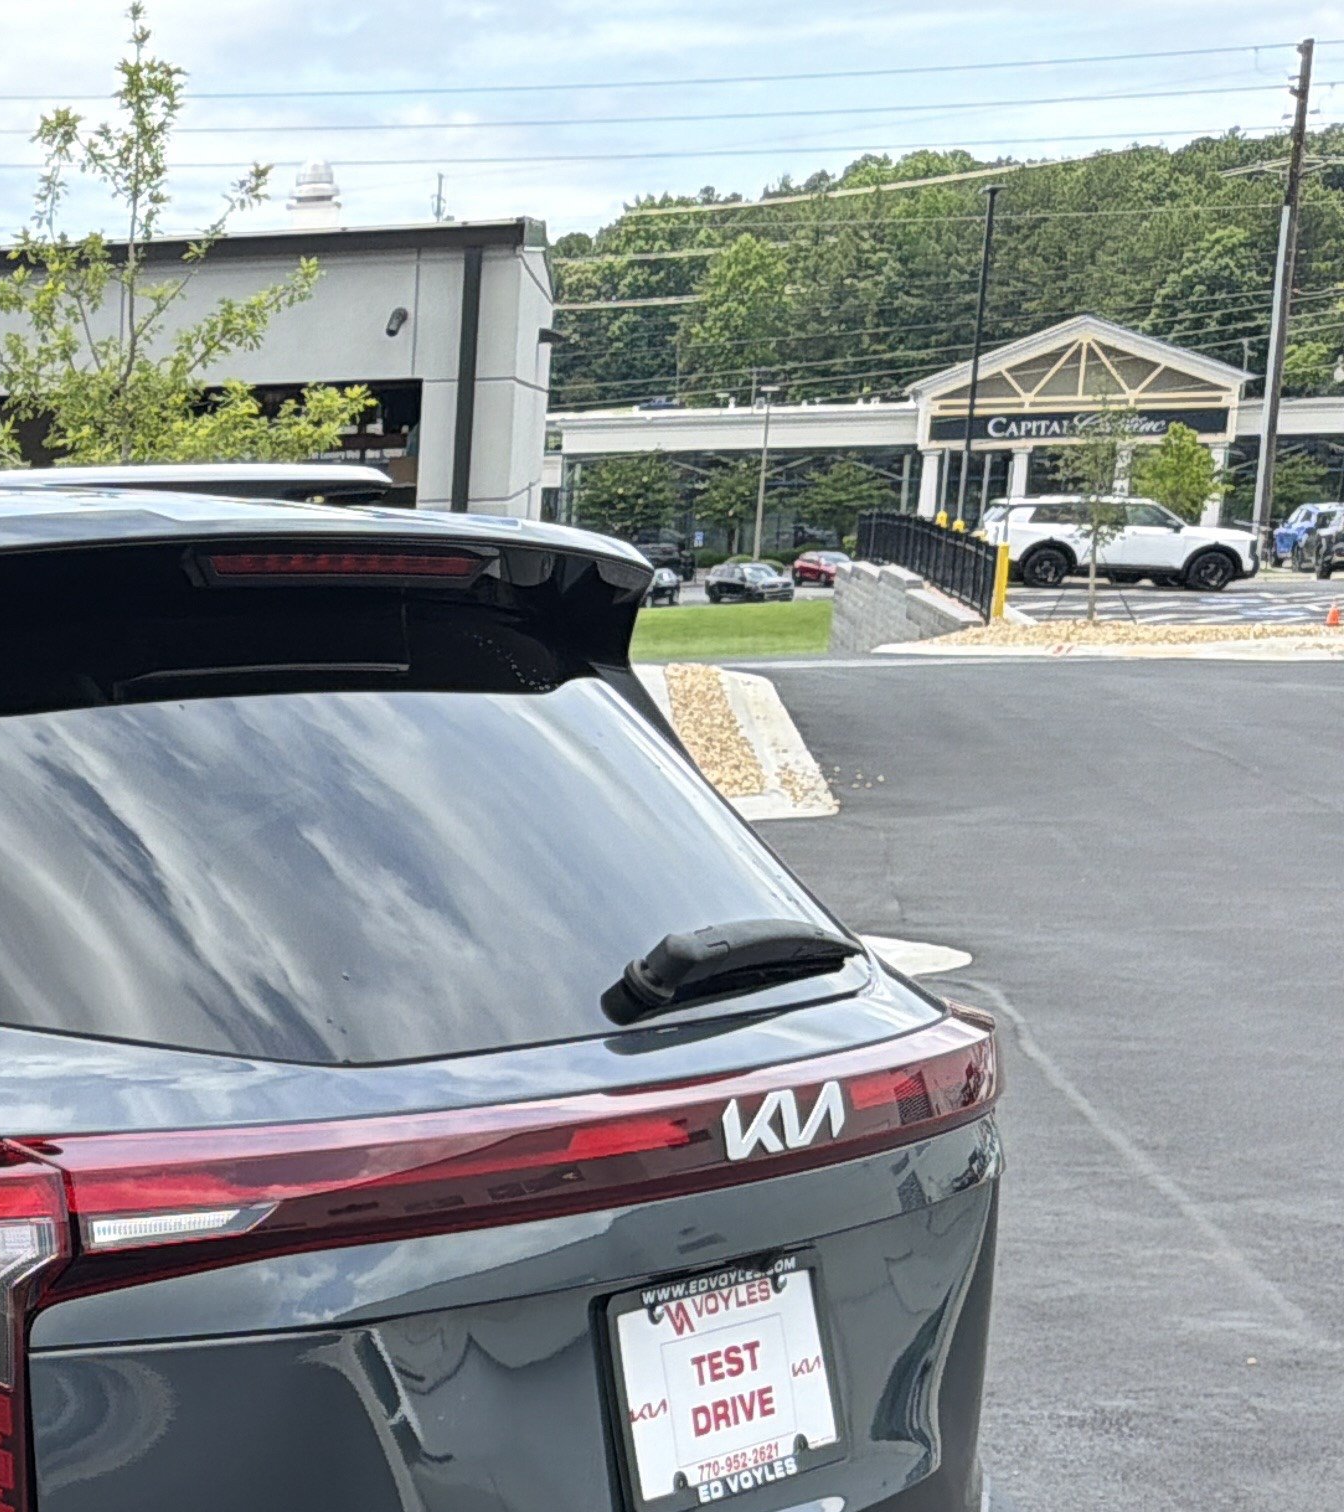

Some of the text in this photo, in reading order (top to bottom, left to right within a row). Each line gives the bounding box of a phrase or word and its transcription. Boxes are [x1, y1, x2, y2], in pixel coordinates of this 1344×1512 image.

[721, 1080, 845, 1161] KIA
[691, 1279, 772, 1319] VOYLES
[691, 1340, 761, 1386] TEST
[691, 1385, 776, 1438] DRIVE
[697, 1441, 780, 1482] 770-952-2621
[698, 1457, 798, 1503] ED VOYLES
